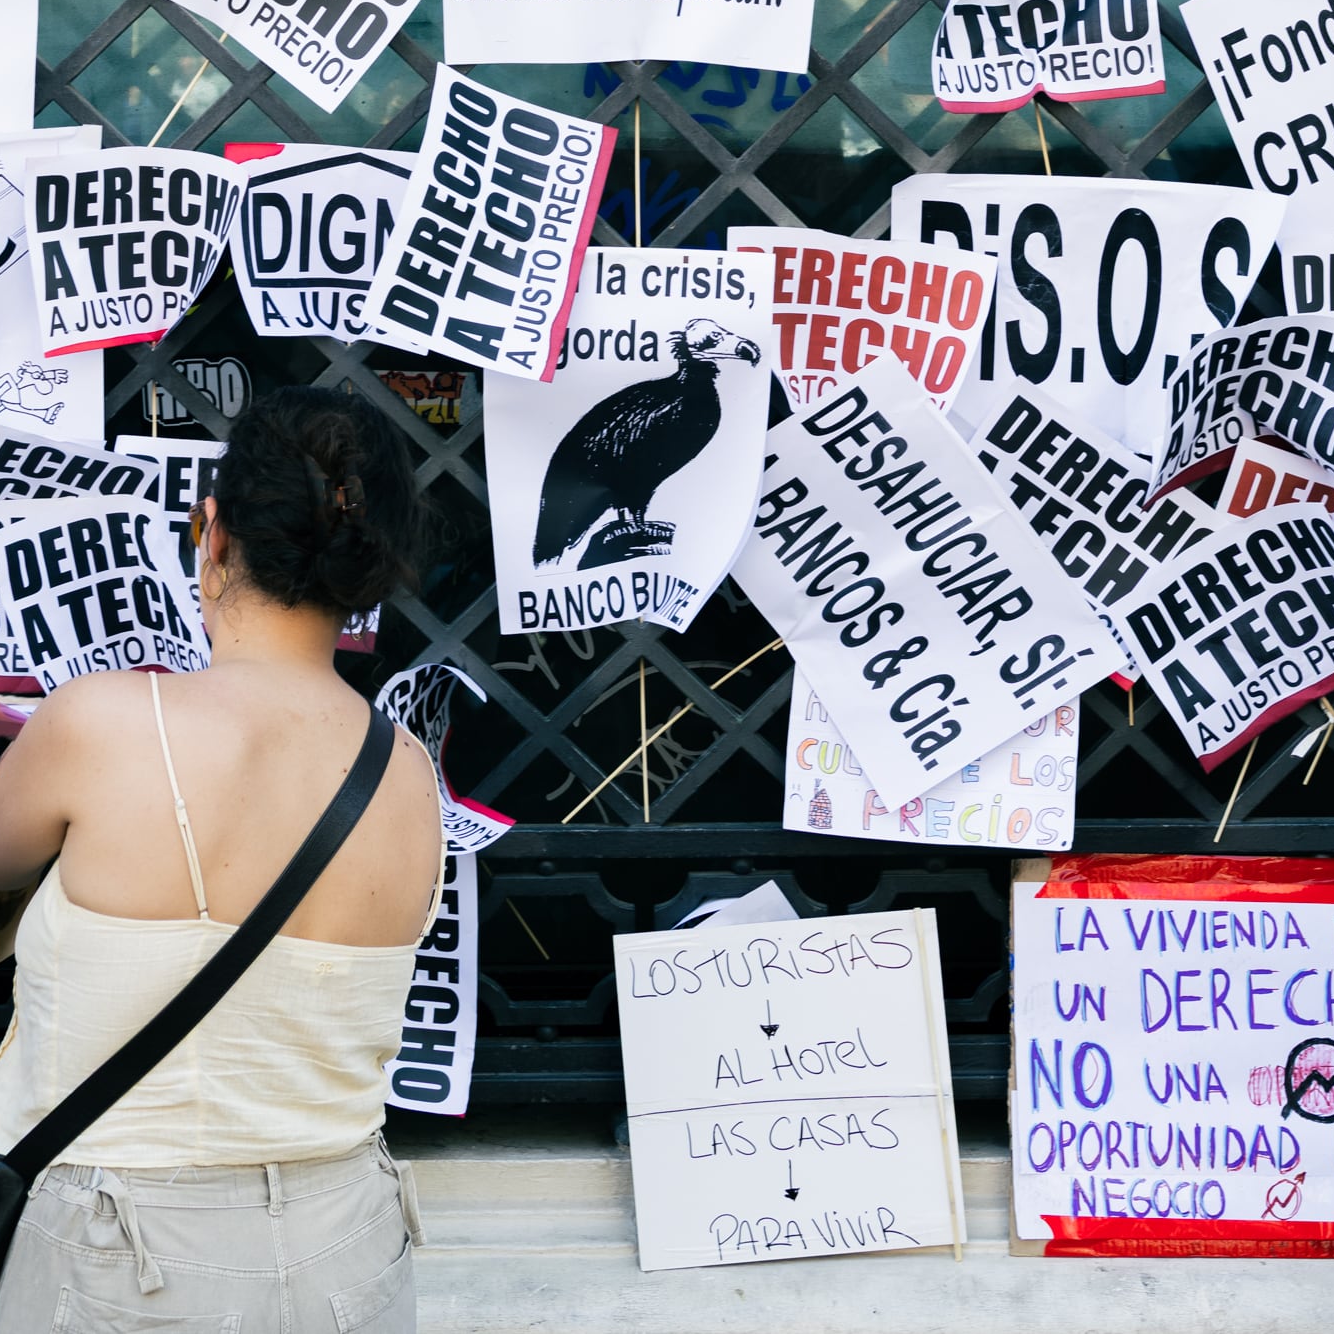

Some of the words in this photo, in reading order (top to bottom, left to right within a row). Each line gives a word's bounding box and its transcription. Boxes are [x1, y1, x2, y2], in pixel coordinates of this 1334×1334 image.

[249, 2, 356, 94] PRECIO!
[36, 166, 240, 249] DERECHO
[381, 81, 498, 336] DERECHO
[462, 107, 561, 307] TECHO
[511, 246, 559, 347] JUSTO
[543, 122, 598, 245] PRECIO!
[596, 253, 627, 296] la
[642, 256, 757, 309] crisis,
[76, 293, 153, 333] JUSTO
[802, 386, 1034, 658] DESAHUCIAR,
[754, 478, 905, 649] BANCOS
[518, 576, 624, 630] BANCO
[863, 635, 930, 690] &
[890, 673, 969, 771] Cía.
[1223, 663, 1306, 732] JUSTO
[1012, 752, 1075, 790] LOS
[1055, 907, 1108, 953] LA
[1124, 909, 1309, 953] VIVIENDA
[1055, 981, 1107, 1022] UN
[715, 1052, 762, 1090] AL
[1030, 1040, 1113, 1110] NO
[1145, 1066, 1228, 1103] UNA
[687, 1117, 757, 1161] LAS
[770, 1106, 900, 1154] CASAS
[1028, 1122, 1300, 1173] OPORTUNIDAD
[1072, 1176, 1227, 1218] NEGOCIO
[710, 1213, 819, 1260] PARA
